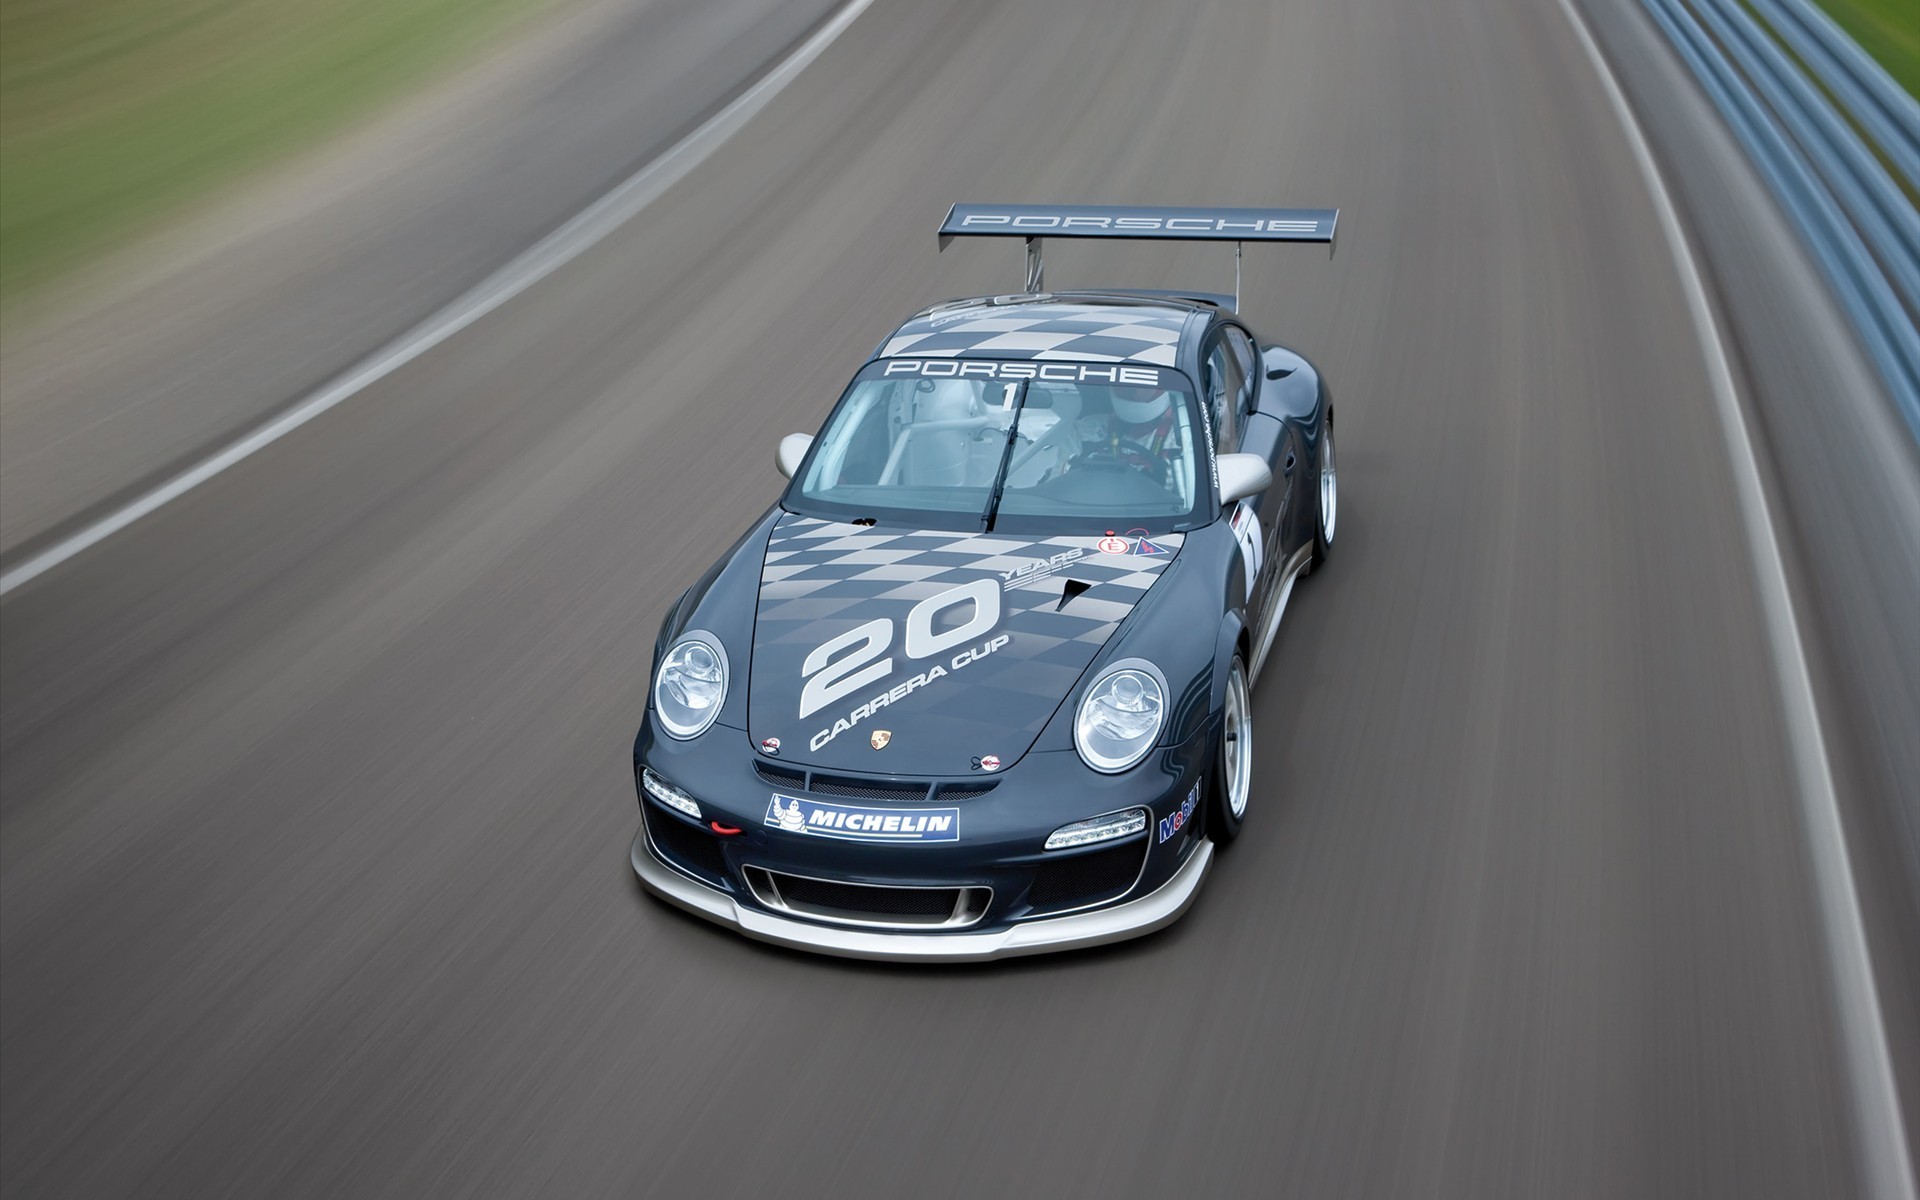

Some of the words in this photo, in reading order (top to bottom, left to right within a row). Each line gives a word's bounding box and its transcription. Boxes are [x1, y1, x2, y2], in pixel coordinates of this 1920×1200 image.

[961, 215, 1319, 232] PORSCHE
[884, 361, 1159, 386] PORSCHE
[1003, 383, 1017, 411] 1
[799, 578, 1001, 720] 20
[999, 548, 1084, 580] YEARS
[810, 665, 948, 752] CARRERA
[951, 634, 1010, 670] CUP
[809, 809, 952, 832] MICHELIN
